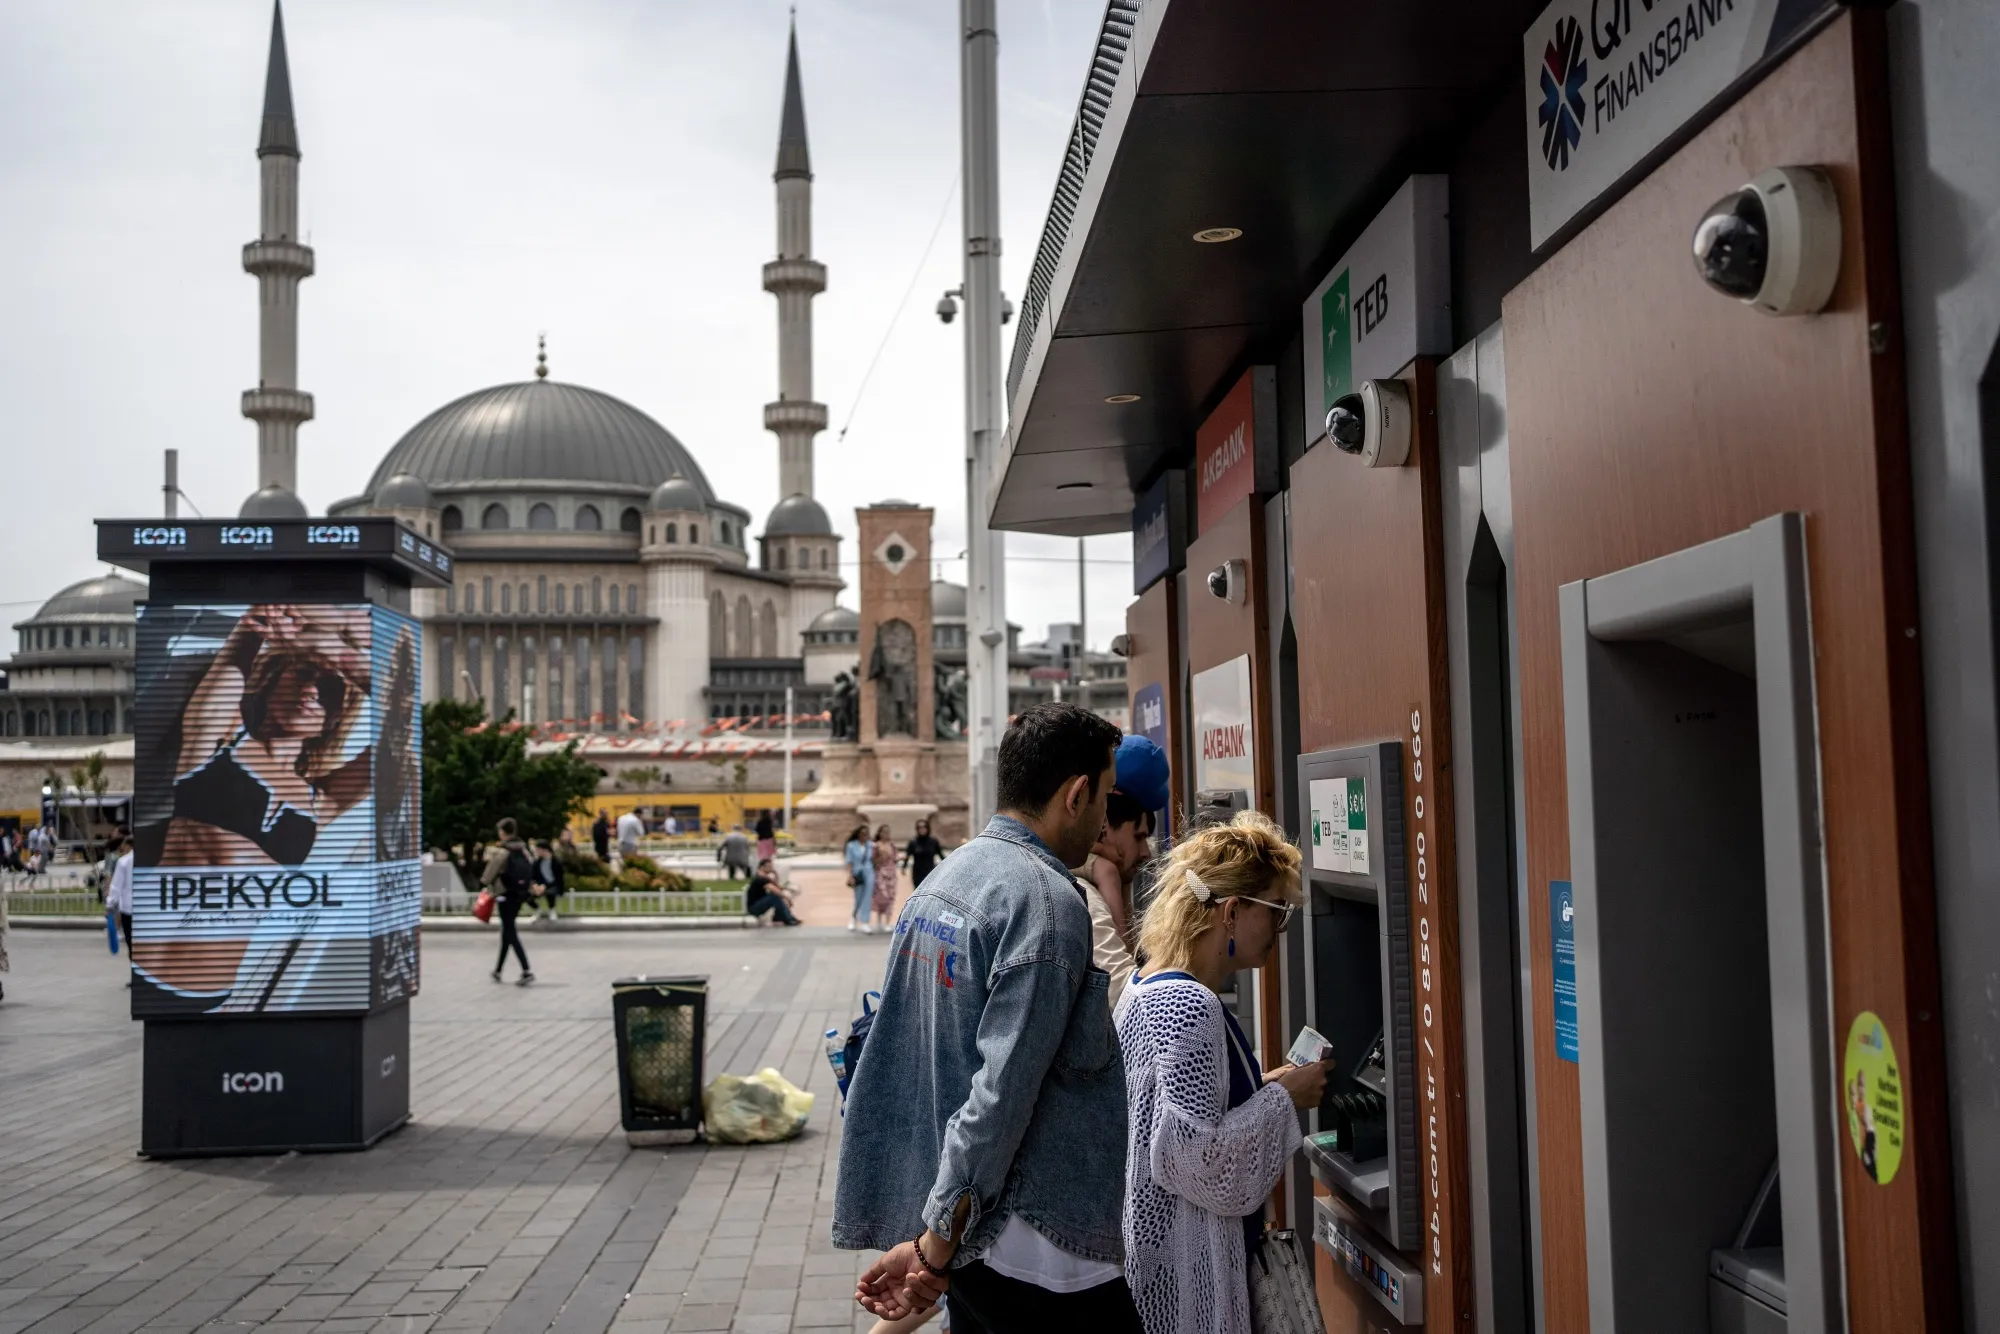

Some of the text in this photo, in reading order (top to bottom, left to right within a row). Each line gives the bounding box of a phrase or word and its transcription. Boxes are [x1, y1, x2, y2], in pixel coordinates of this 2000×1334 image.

[1353, 273, 1389, 344] TEB
[1202, 421, 1246, 493] AKBANK
[133, 527, 186, 545] icon
[220, 526, 273, 544] icon
[307, 525, 360, 543] icon
[1203, 723, 1246, 761] AKBANK
[1411, 709, 1423, 783] 666
[1415, 795, 1425, 819] 0
[1321, 821, 1331, 837] TEB
[1416, 832, 1428, 905] 200
[914, 917, 958, 946] TRAVEL
[1420, 917, 1431, 992] 850
[223, 1071, 284, 1093] icon
[1427, 1067, 1442, 1276] teb.com.tr
